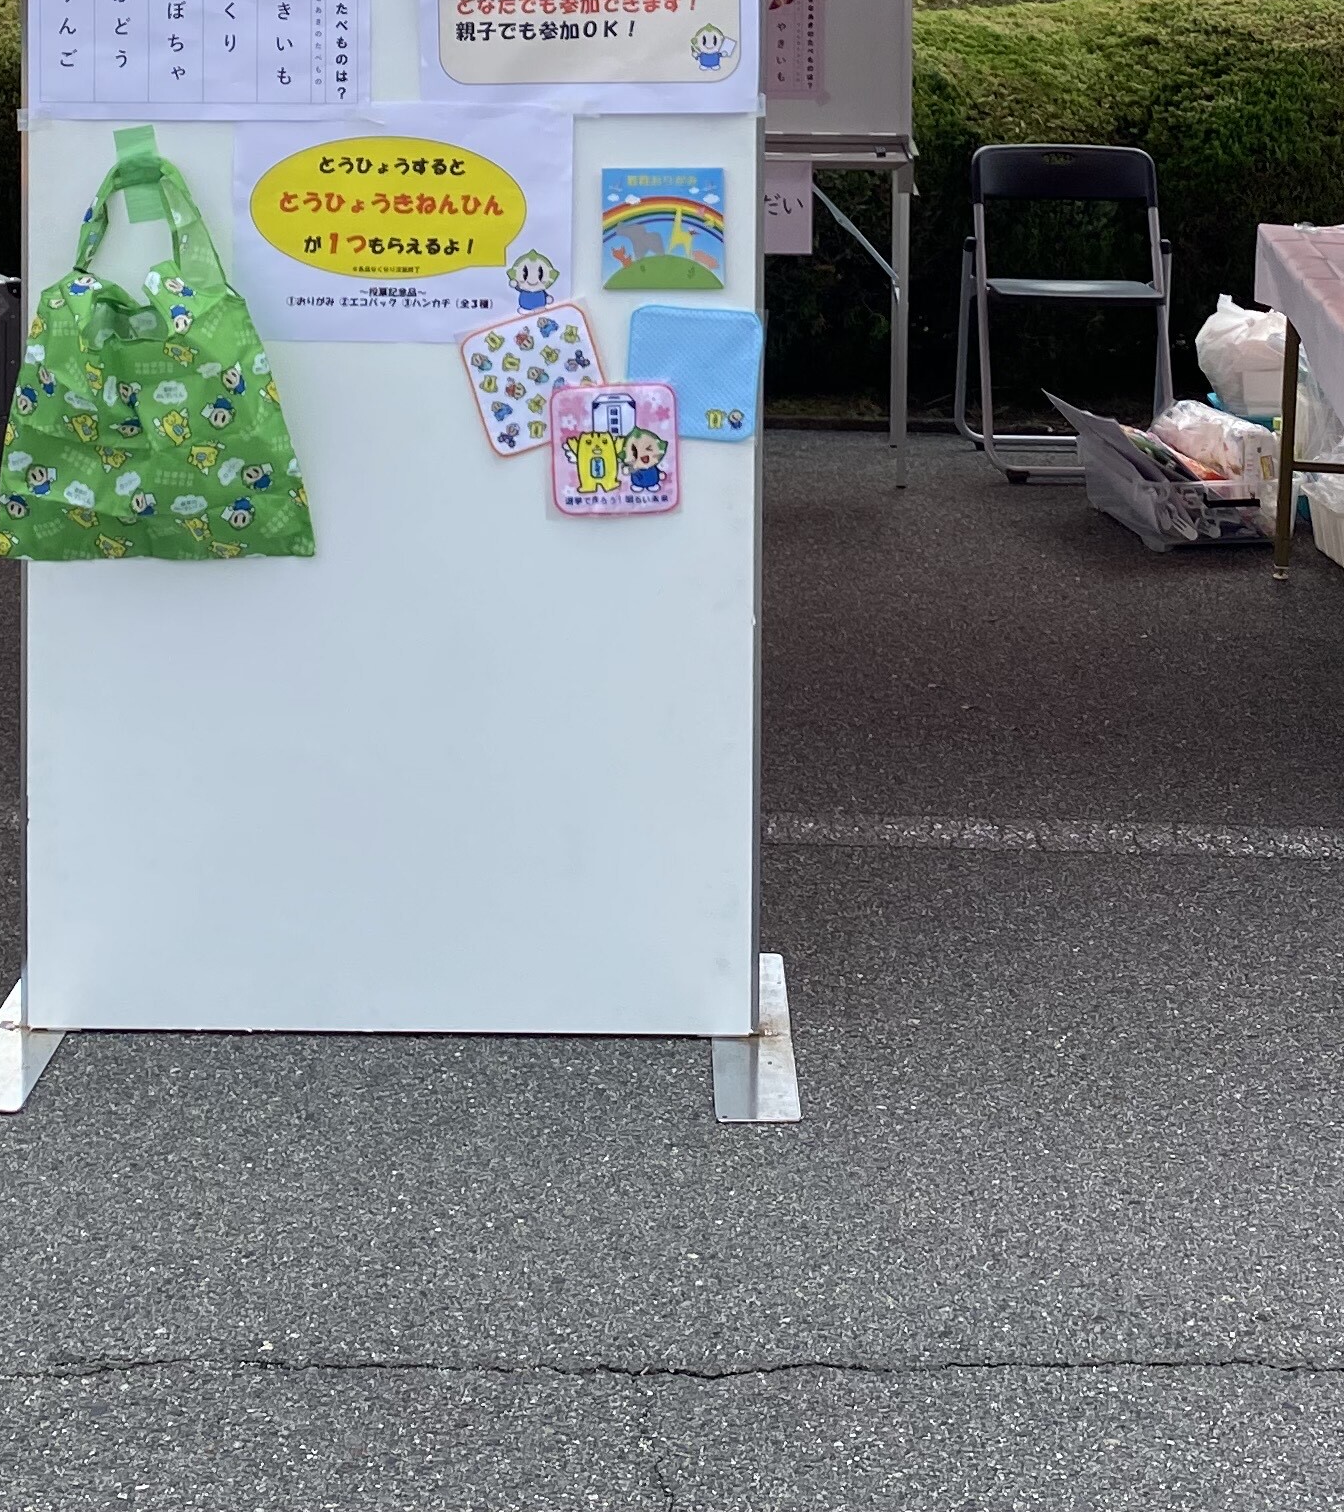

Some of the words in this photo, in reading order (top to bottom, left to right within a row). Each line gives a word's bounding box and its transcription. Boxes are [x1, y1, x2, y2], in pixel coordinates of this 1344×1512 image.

[223, 1, 237, 52] くり
[319, 156, 467, 176] とうひょうすると
[279, 191, 505, 217] とうひょうきねんひん
